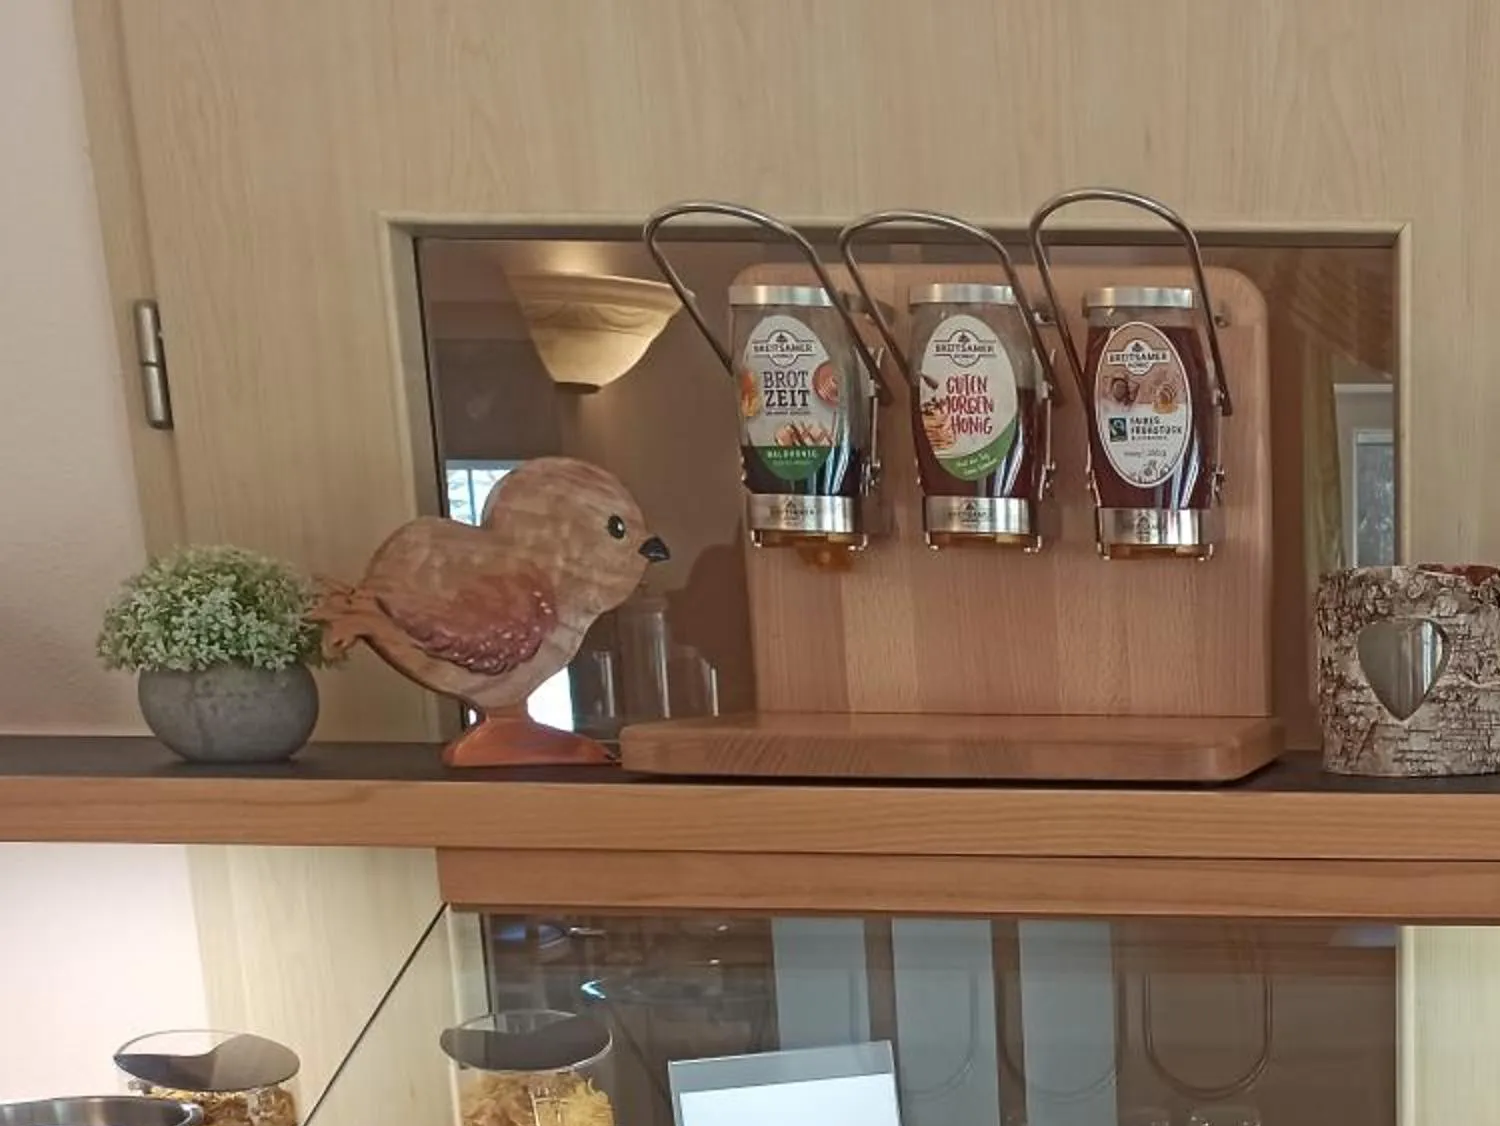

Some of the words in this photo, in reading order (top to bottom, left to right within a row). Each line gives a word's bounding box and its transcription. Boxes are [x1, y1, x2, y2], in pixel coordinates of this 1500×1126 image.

[763, 371, 808, 388] BROT
[945, 375, 988, 395] GUTEN
[764, 389, 811, 407] ZEIT
[938, 395, 994, 416] MORGEN
